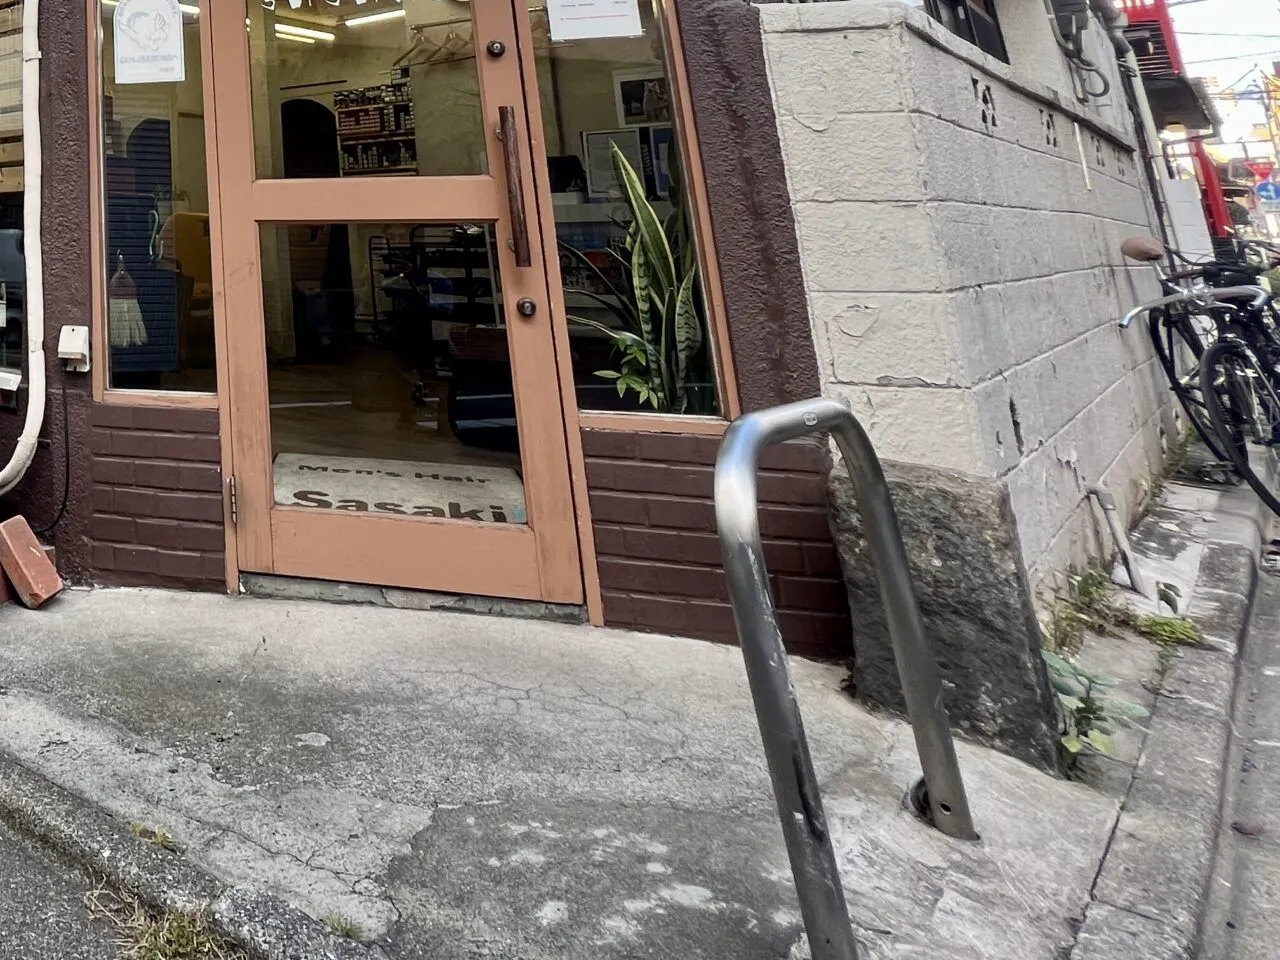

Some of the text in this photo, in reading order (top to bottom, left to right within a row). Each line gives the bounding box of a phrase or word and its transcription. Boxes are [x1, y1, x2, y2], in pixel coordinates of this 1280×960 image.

[297, 464, 493, 484] Men's Hair
[292, 489, 508, 523] Sasaki
